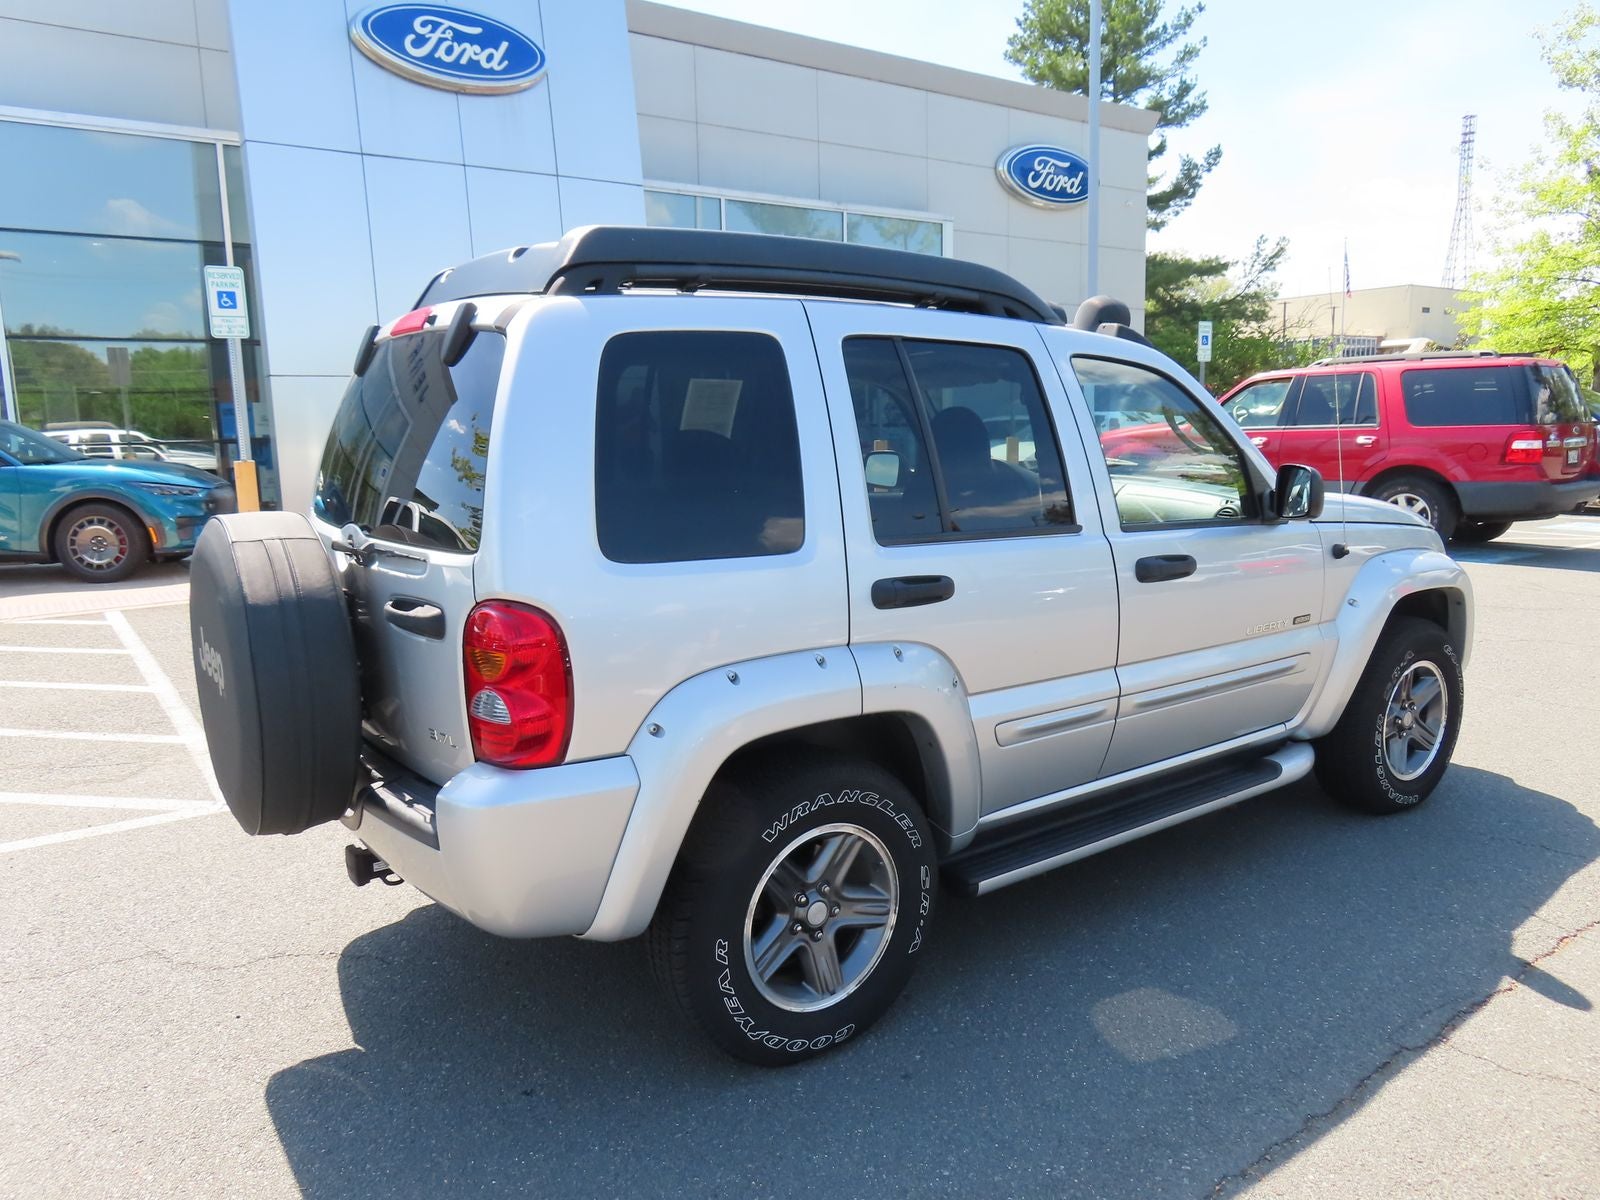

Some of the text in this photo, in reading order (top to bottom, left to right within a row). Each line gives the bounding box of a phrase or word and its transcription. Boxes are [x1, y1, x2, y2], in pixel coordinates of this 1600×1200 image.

[404, 16, 508, 71] Ford
[1028, 156, 1083, 194] Ford
[207, 271, 241, 280] RESERVED
[210, 280, 240, 289] PARKING
[1246, 618, 1288, 635] LIBERTY
[199, 626, 224, 696] Jeep
[428, 727, 459, 749] 3.7L
[762, 790, 922, 849] WRANGLER
[715, 938, 855, 1052] GOODYEAR
